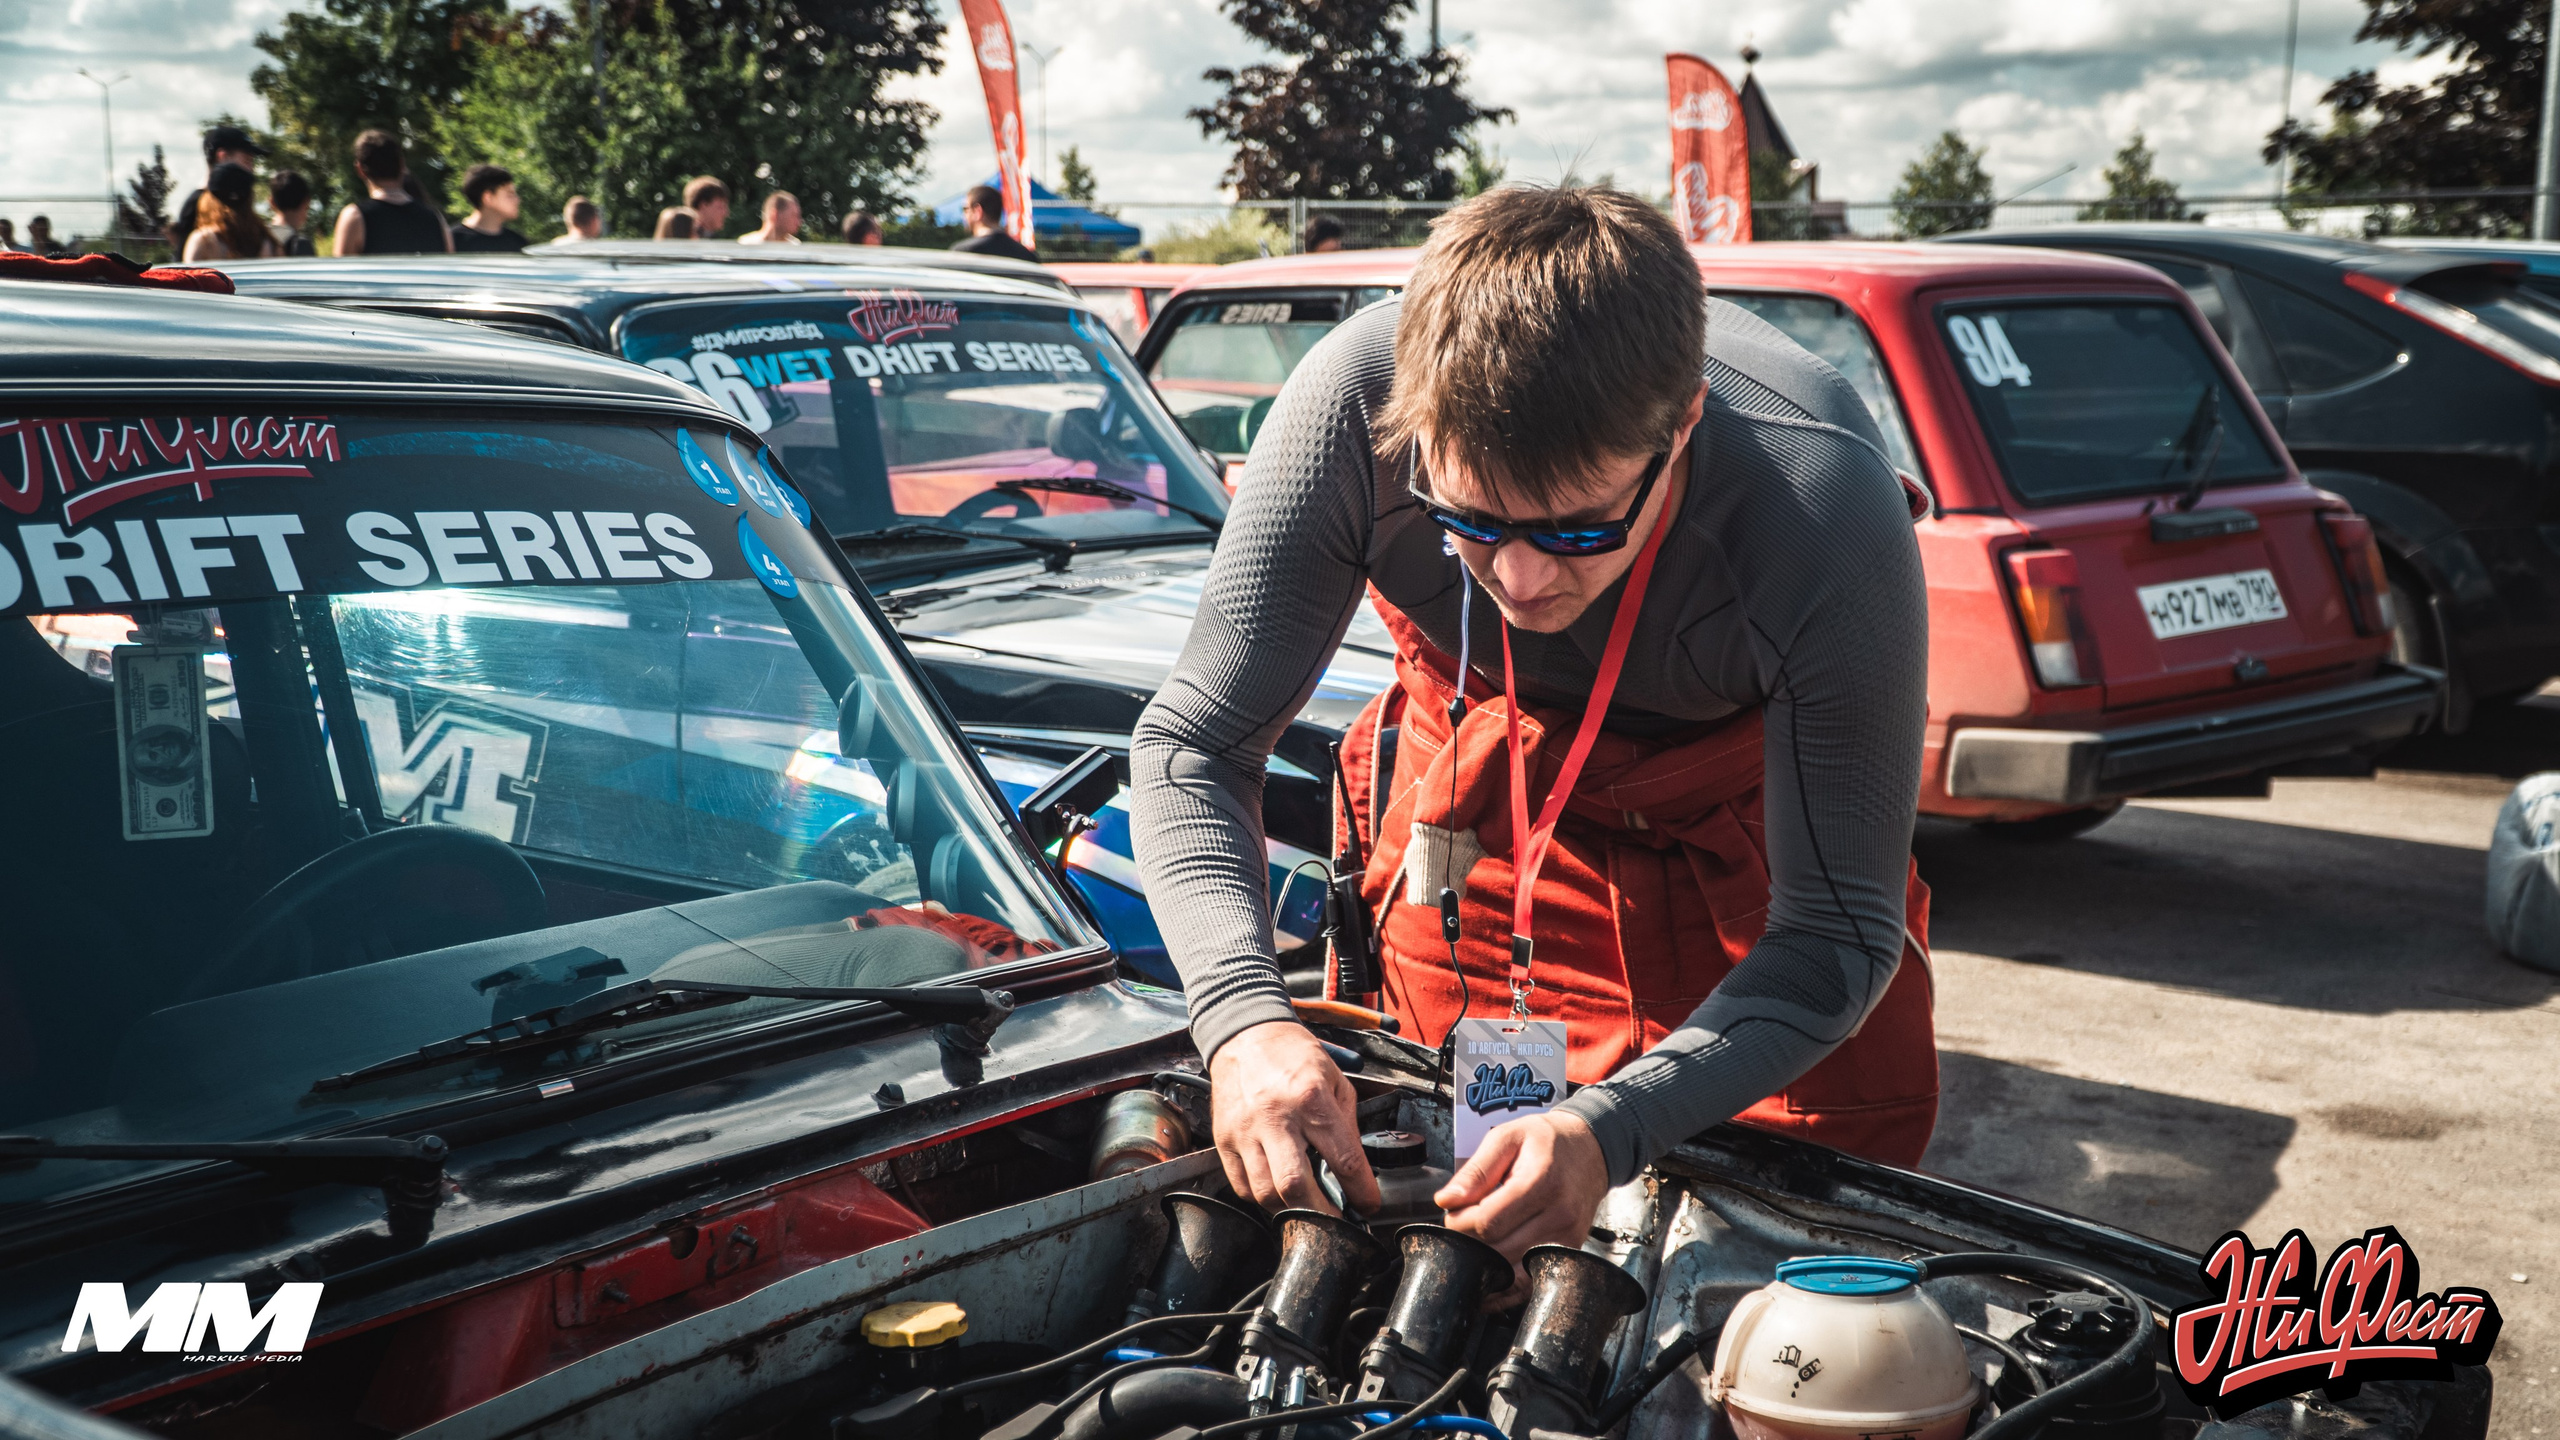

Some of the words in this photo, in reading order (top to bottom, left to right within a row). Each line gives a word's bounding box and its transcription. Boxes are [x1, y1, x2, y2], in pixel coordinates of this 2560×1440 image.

[1946, 315, 2032, 387] 94
[735, 348, 836, 388] WET
[842, 341, 961, 377] DRIFT
[965, 340, 1092, 373] SERIES
[701, 460, 720, 483] 1
[747, 474, 768, 497] 2
[346, 511, 713, 587] SERIES
[762, 553, 782, 576] 4
[773, 578, 790, 586] ЭТАП
[1468, 1042, 1477, 1054] 10
[1479, 1041, 1511, 1055] АВГУСТА
[1517, 1043, 1533, 1056] НКП
[1534, 1043, 1554, 1057] РУСЬ
